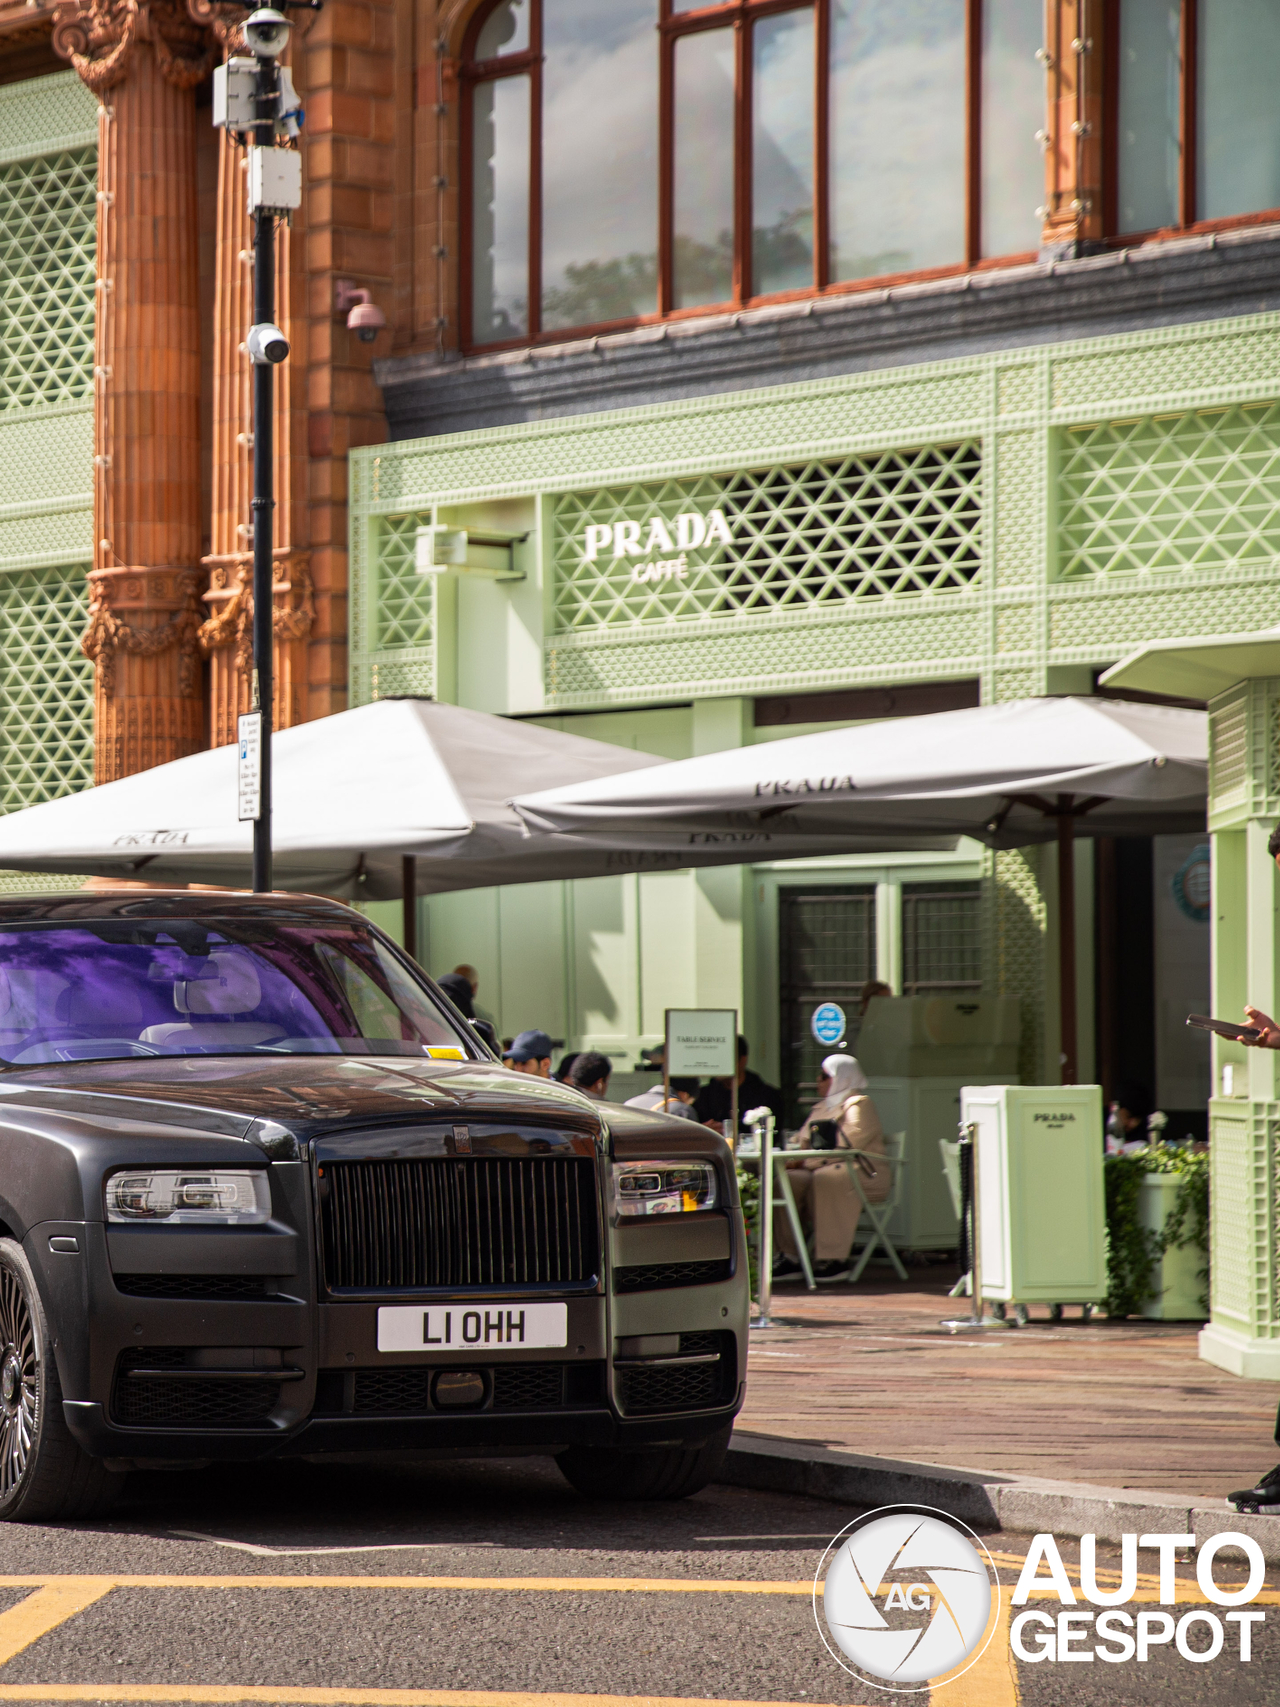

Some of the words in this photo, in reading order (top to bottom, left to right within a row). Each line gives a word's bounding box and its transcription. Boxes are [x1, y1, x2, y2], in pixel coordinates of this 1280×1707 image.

[585, 509, 735, 561] PRADA
[754, 774, 858, 797] PRADA
[114, 832, 189, 845] PRADA
[1033, 1112, 1076, 1122] PRADA
